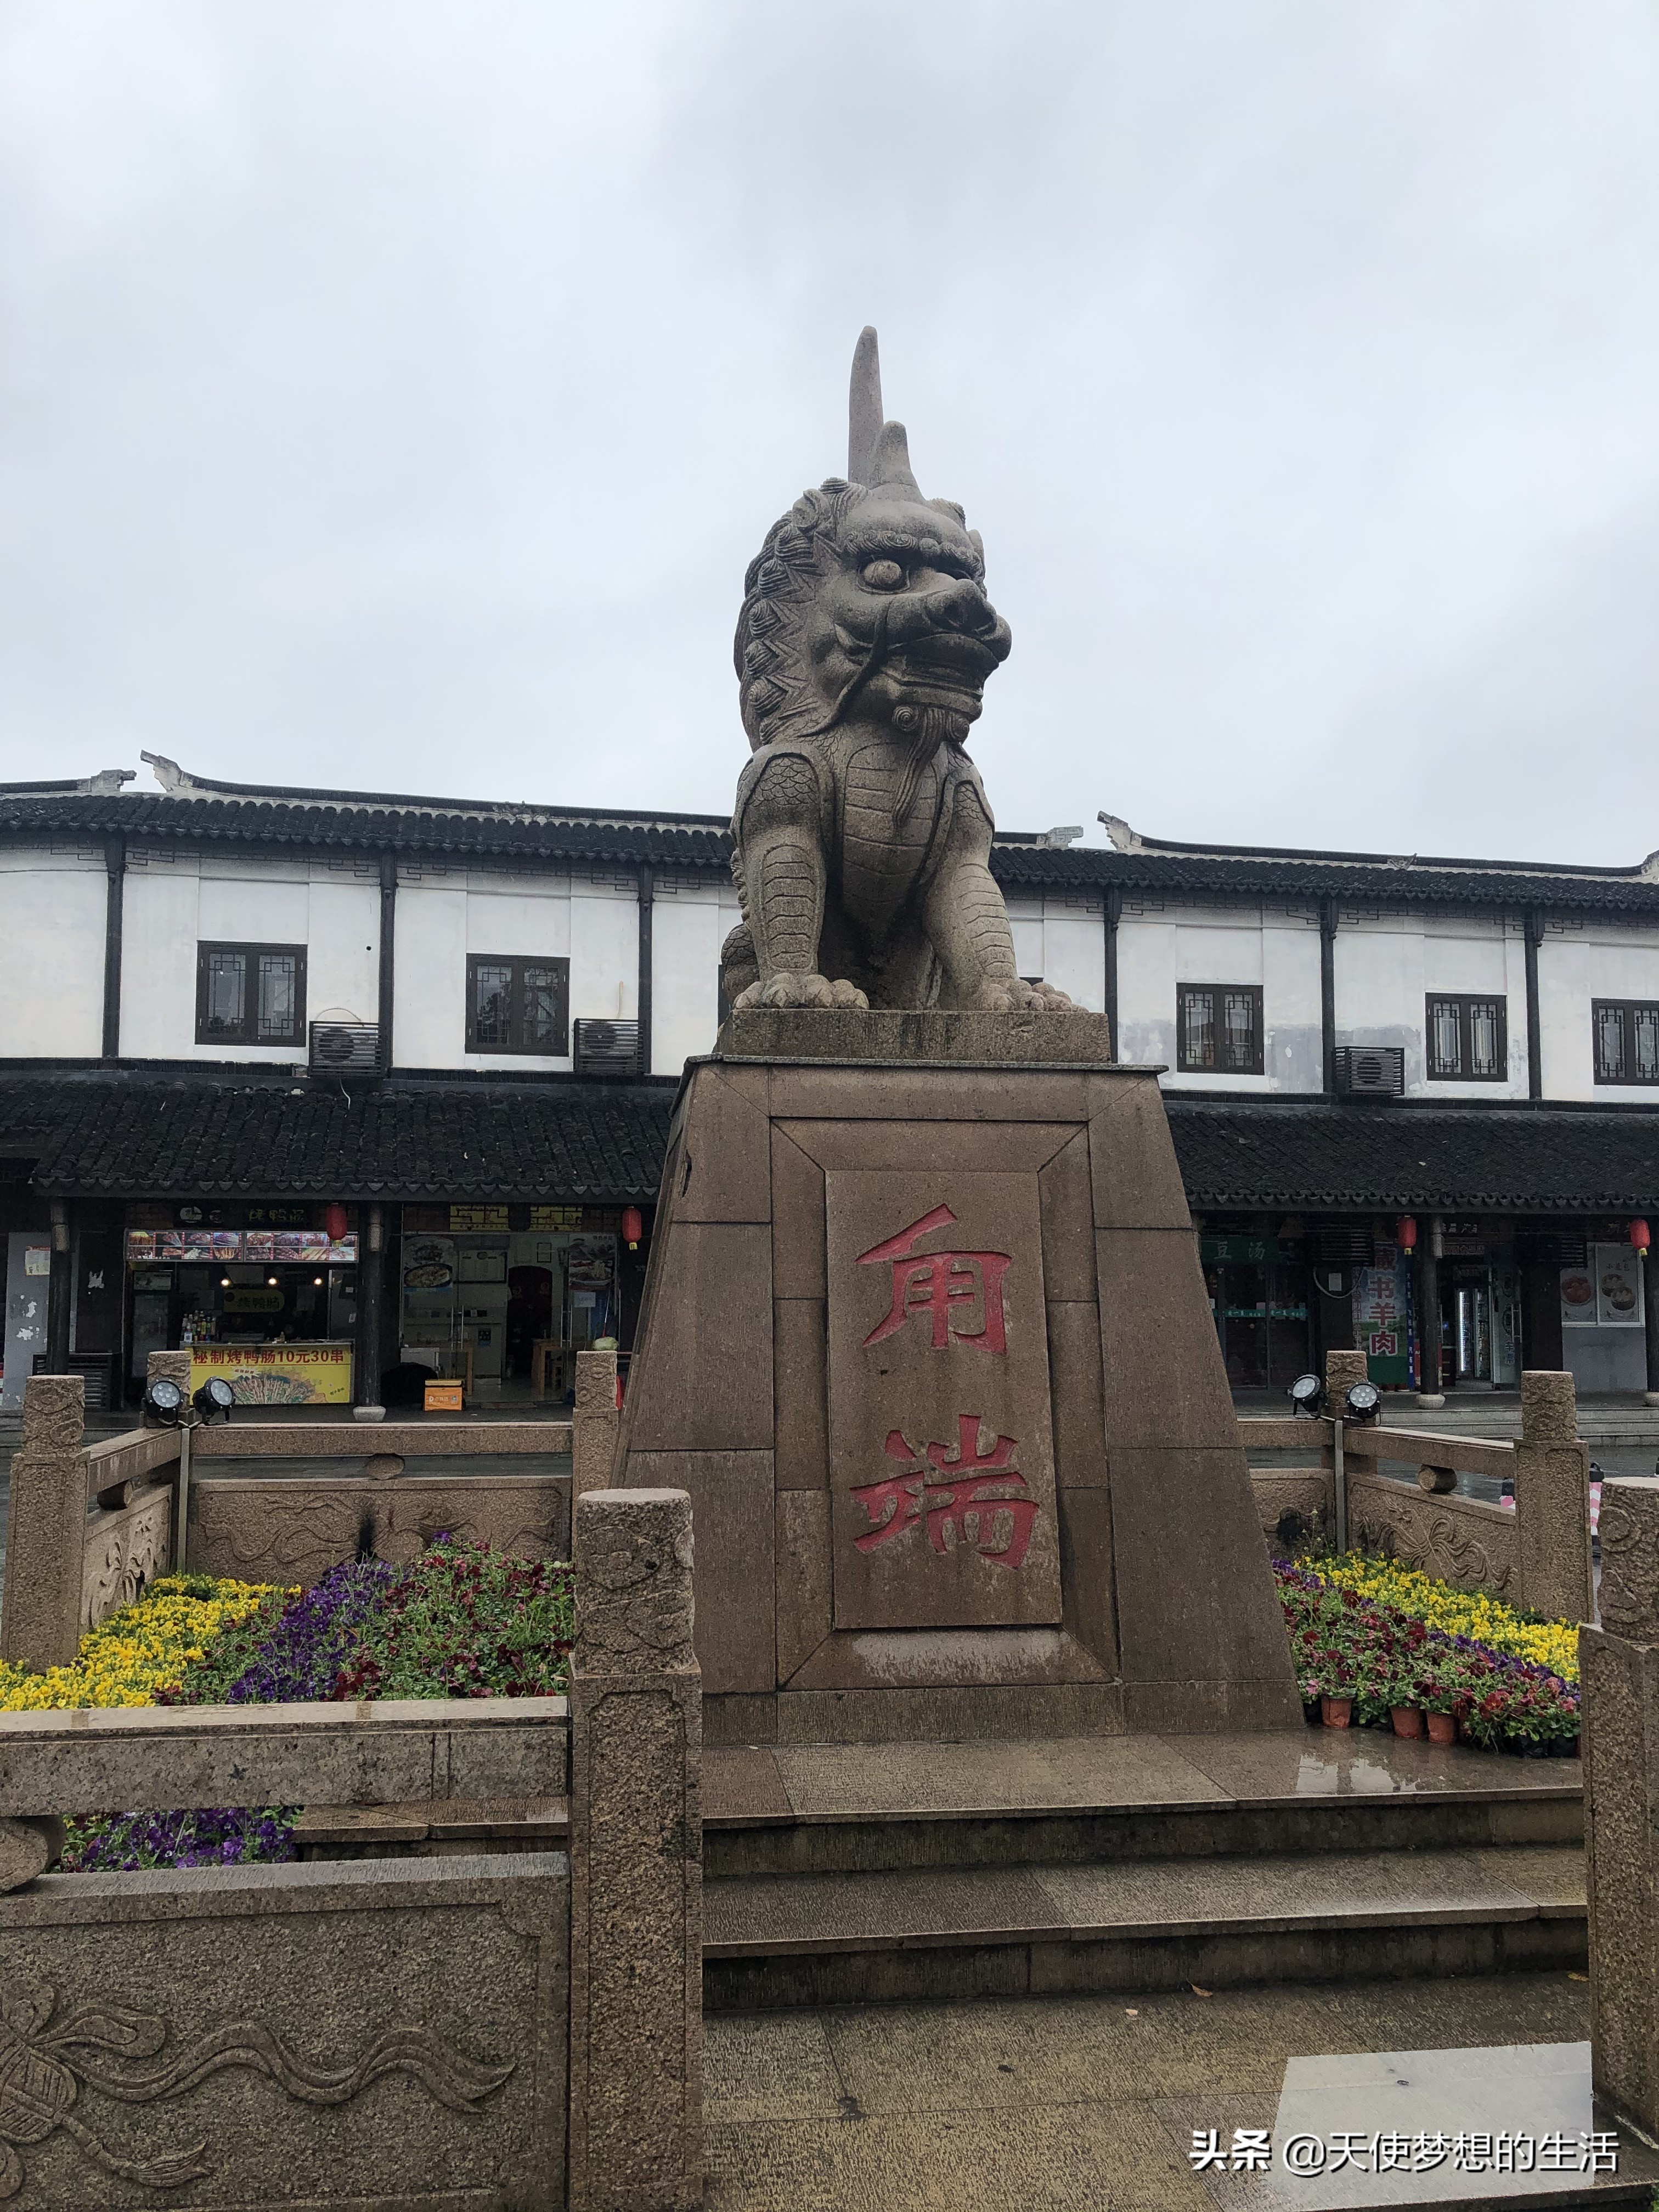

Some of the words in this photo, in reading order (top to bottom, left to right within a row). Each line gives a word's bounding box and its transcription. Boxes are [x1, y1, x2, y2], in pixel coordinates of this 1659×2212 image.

[193, 1348, 344, 1364] 秘制烤鸭肠10元30串
